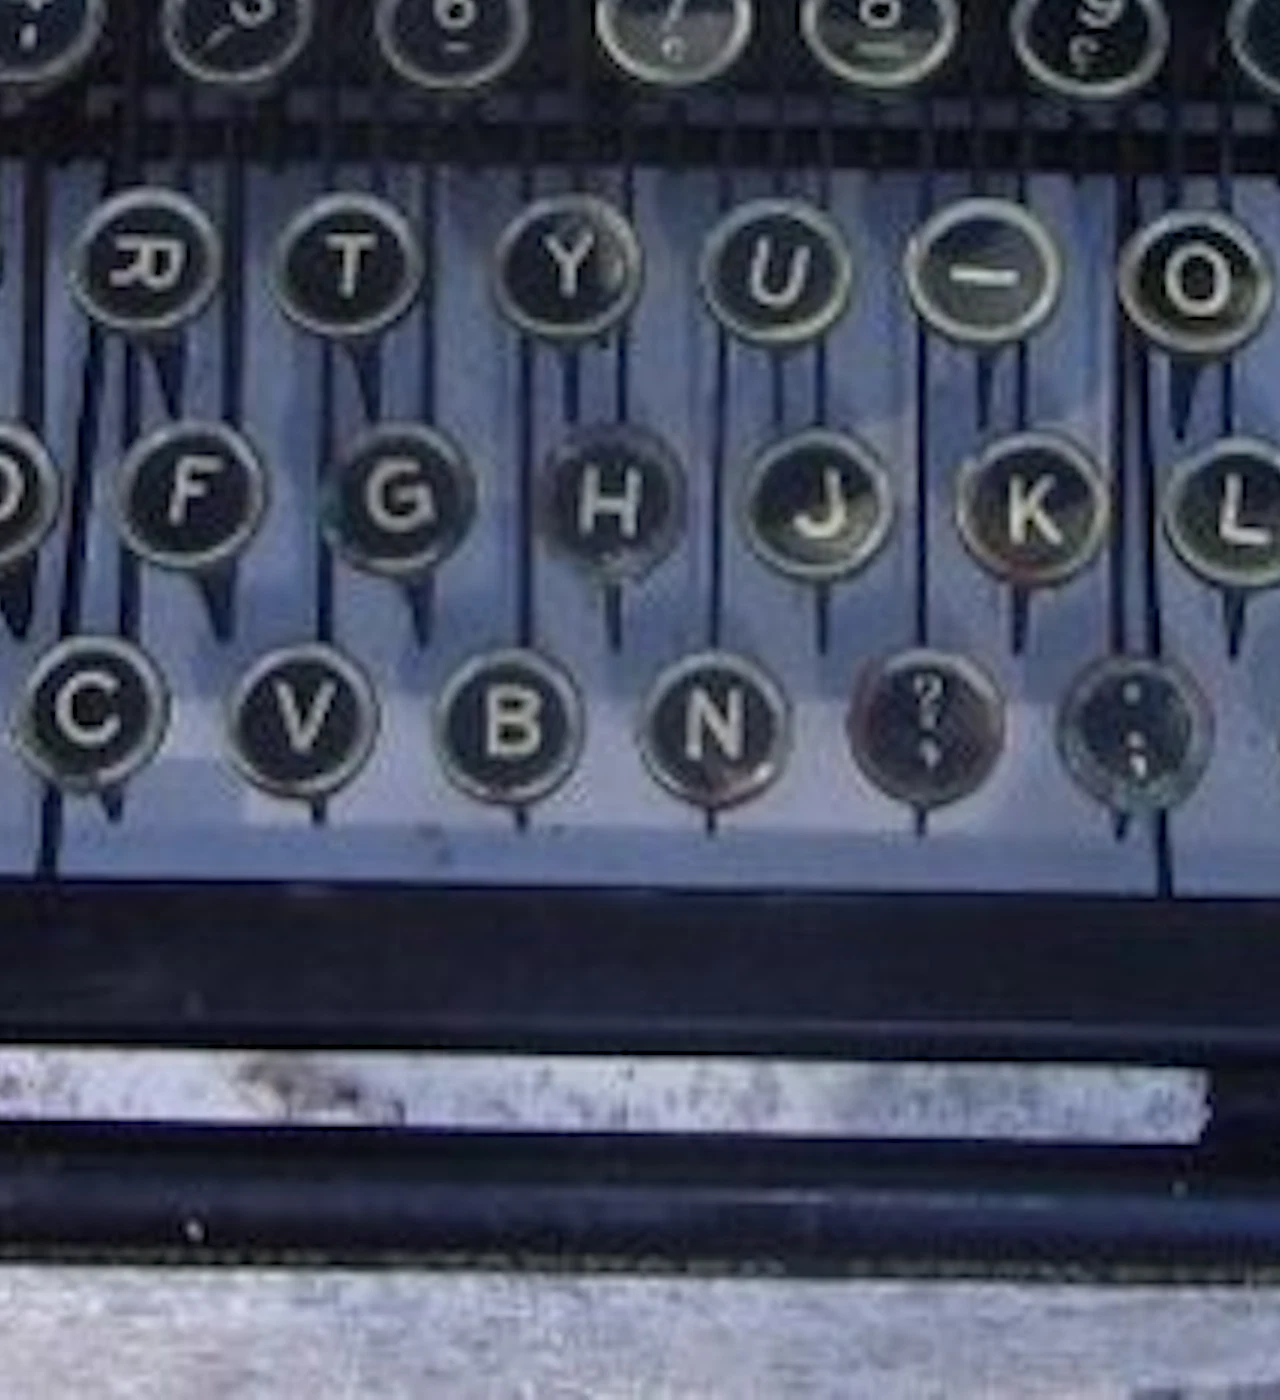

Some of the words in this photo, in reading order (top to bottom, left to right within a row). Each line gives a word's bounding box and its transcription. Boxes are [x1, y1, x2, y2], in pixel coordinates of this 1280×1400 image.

[110, 236, 185, 290] R
[325, 233, 375, 297] T
[545, 232, 593, 297] Y
[749, 237, 810, 307] U
[1165, 242, 1232, 317] O
[169, 455, 223, 525] F
[365, 459, 436, 532] G
[578, 464, 642, 538] H
[794, 473, 843, 539] J
[1008, 475, 1063, 546] K
[1221, 473, 1272, 545] L
[54, 670, 121, 744] C
[274, 680, 336, 752] V
[486, 684, 542, 757] B
[686, 689, 742, 761] N
